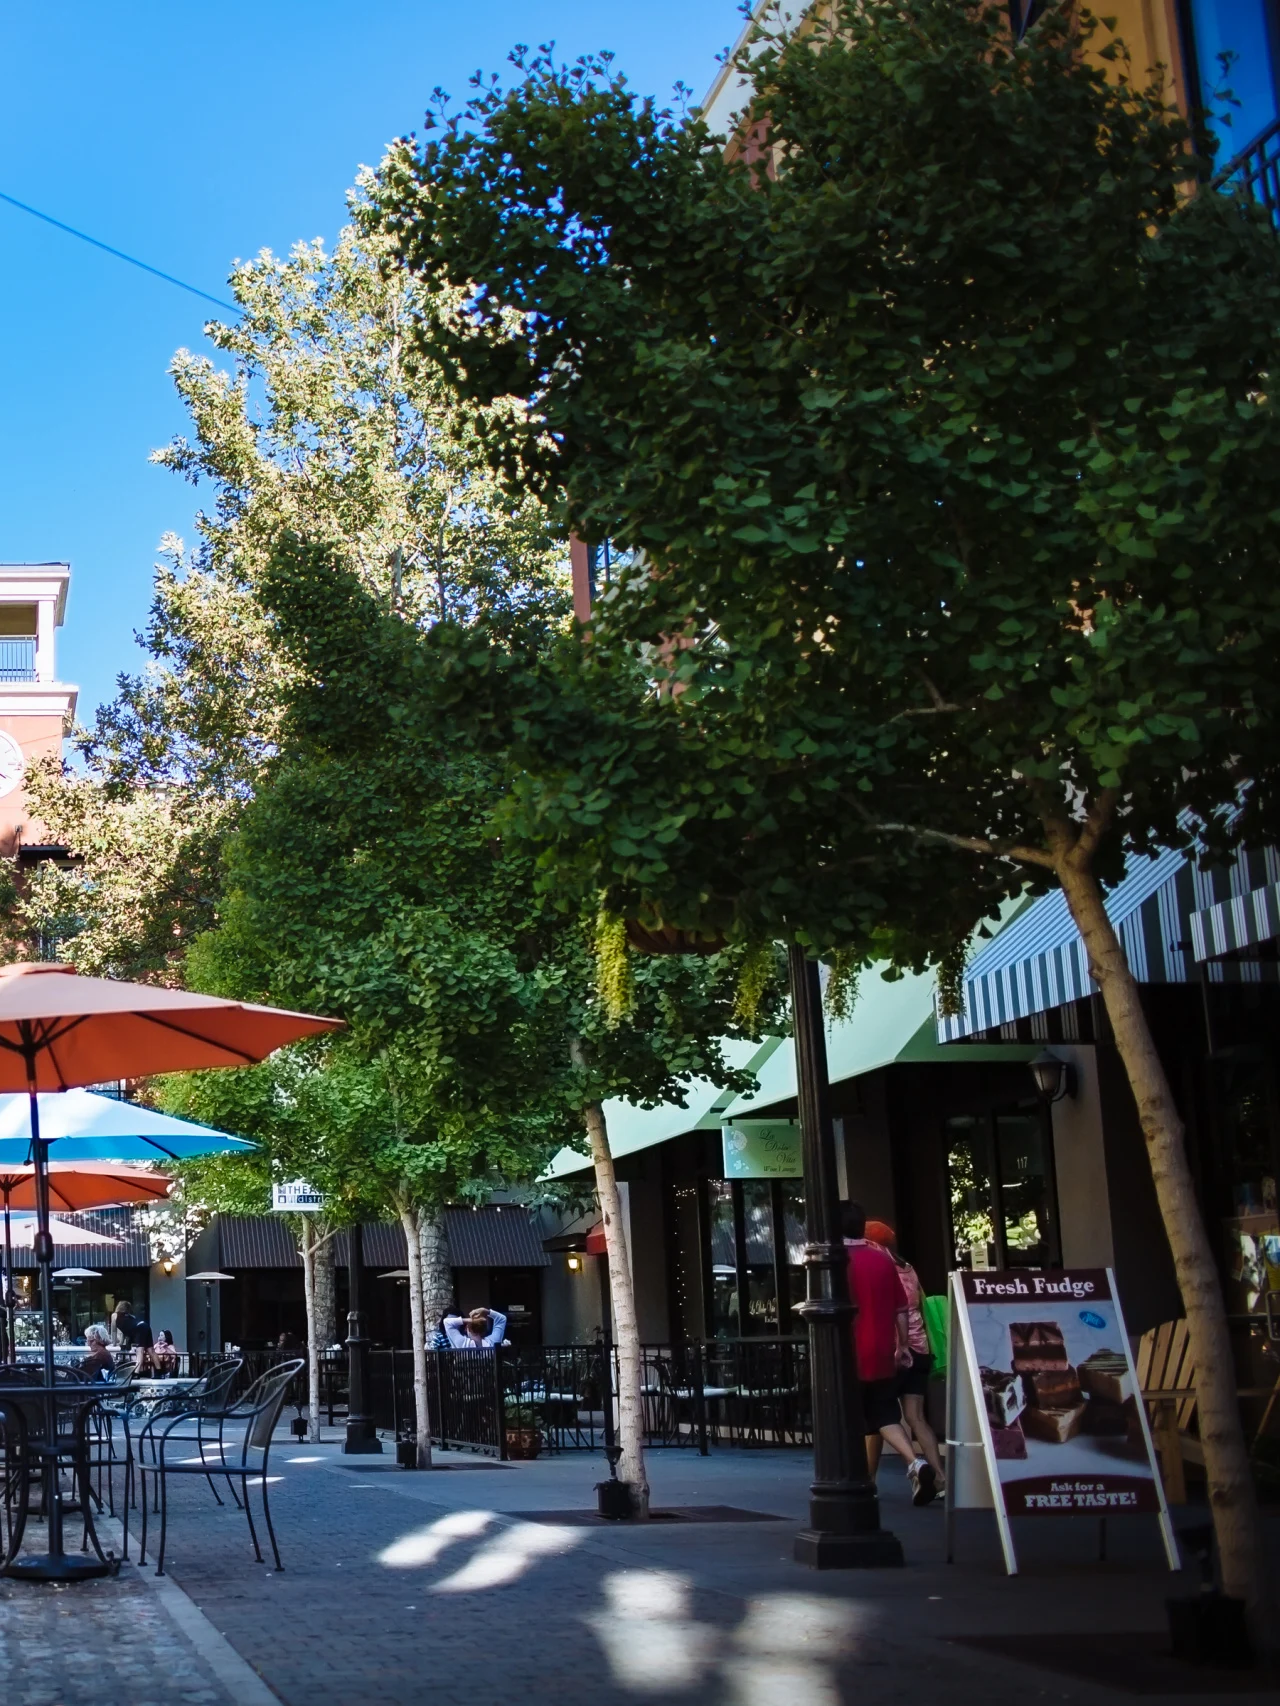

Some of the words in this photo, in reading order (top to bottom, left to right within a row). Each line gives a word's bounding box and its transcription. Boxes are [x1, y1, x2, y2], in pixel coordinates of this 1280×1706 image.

[1017, 1156, 1028, 1169] 117
[288, 1185, 319, 1195] THEA
[973, 1278, 1029, 1295] Fresh
[1032, 1278, 1095, 1298] Fudge
[1050, 1482, 1074, 1492] Ask
[1075, 1482, 1094, 1492] for
[1096, 1484, 1105, 1492] a
[1024, 1494, 1072, 1508] FREE
[1073, 1492, 1137, 1507] TASTE!
